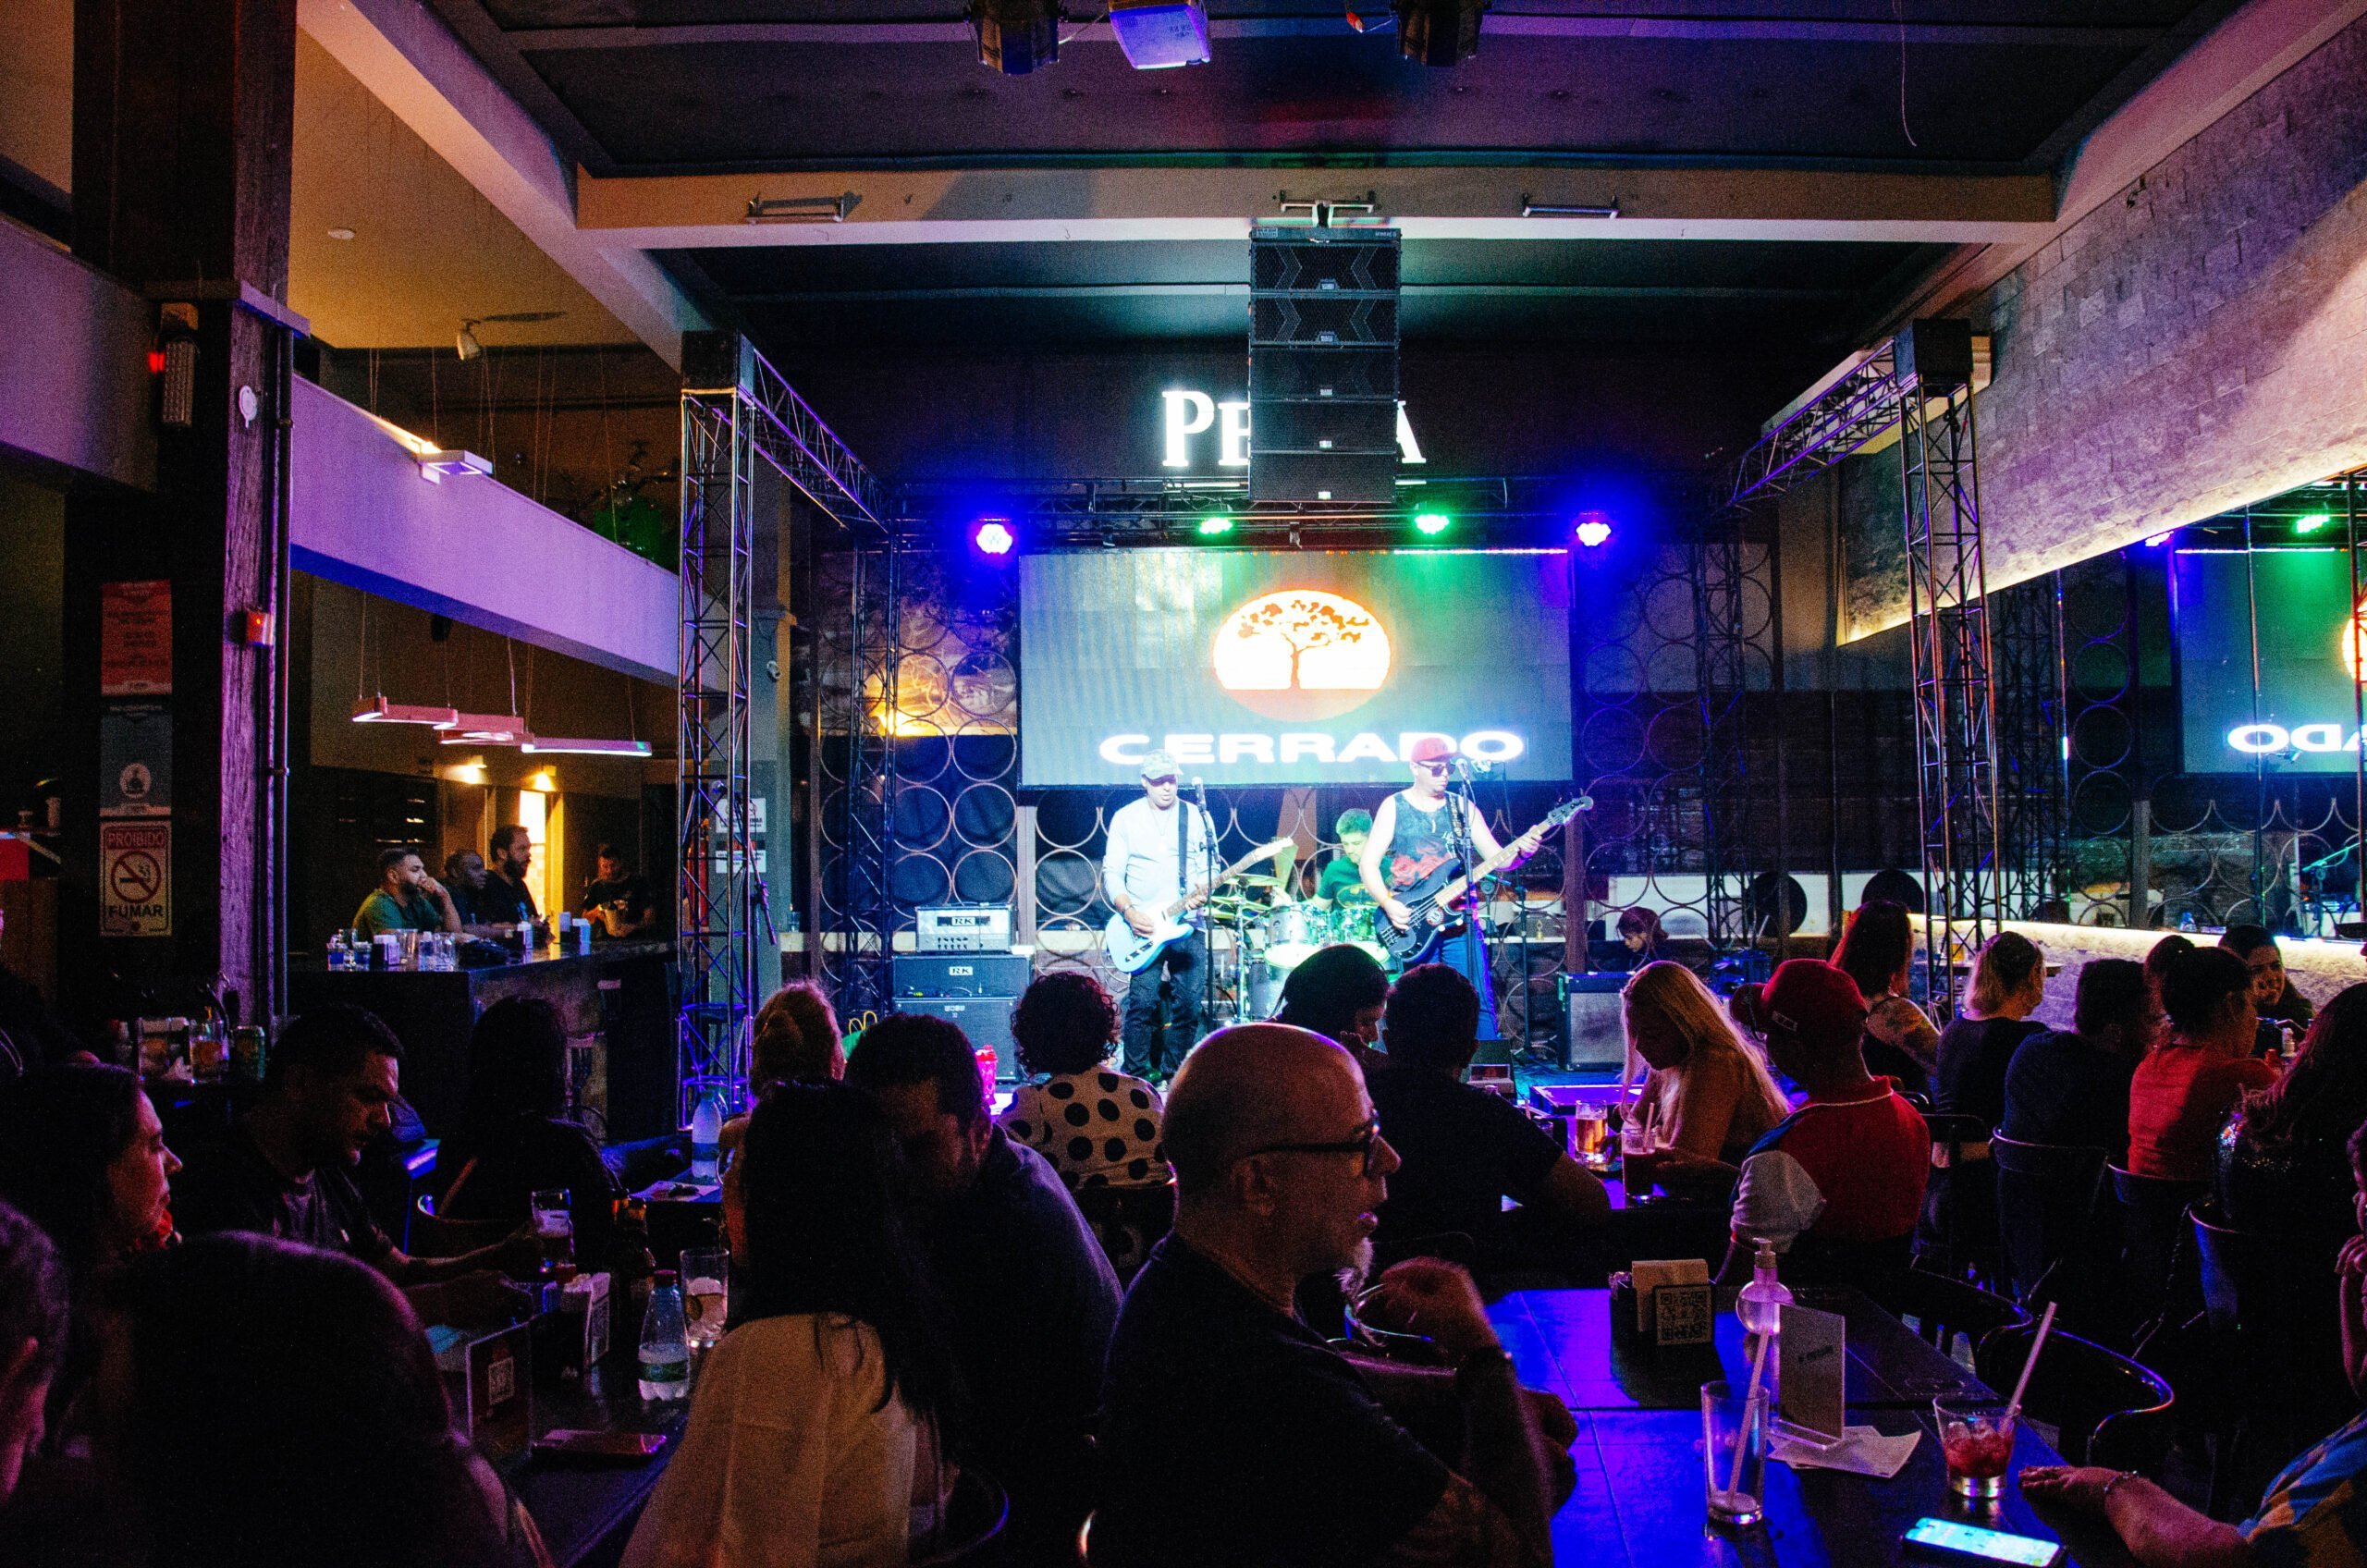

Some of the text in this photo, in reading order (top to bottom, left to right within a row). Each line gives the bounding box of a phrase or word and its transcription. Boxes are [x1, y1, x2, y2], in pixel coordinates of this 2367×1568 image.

[1098, 729, 1525, 765] CERRADO
[108, 831, 164, 847] PROIBIDO
[108, 904, 164, 917] FUMAR
